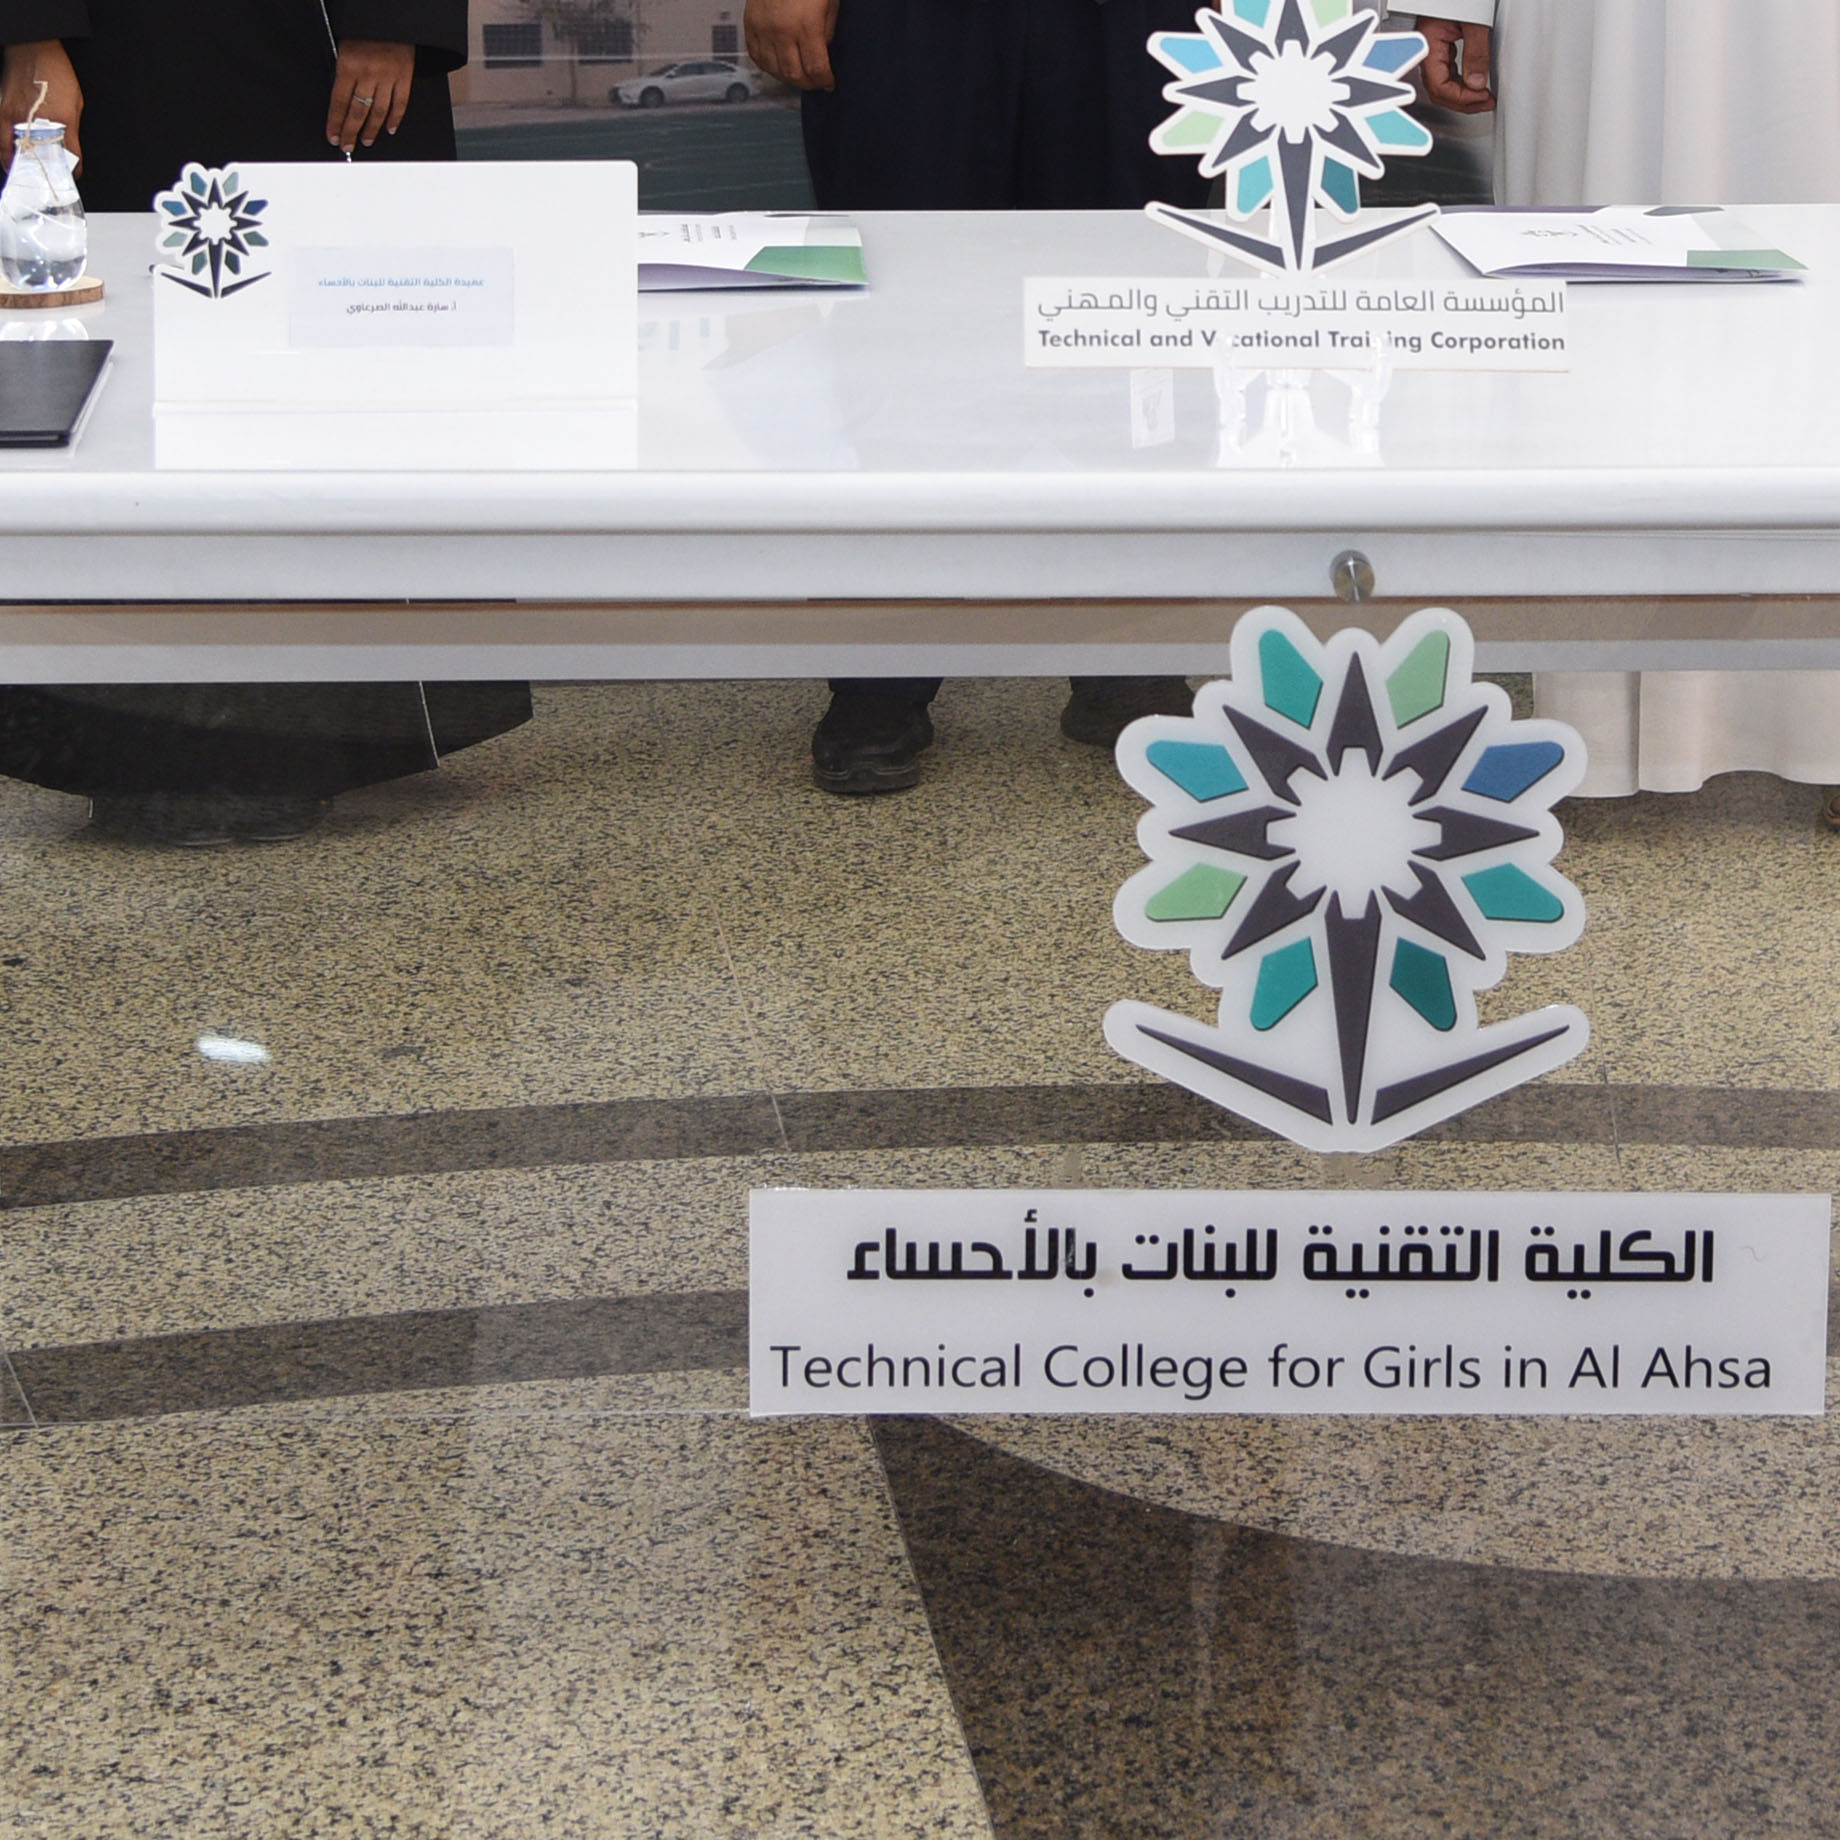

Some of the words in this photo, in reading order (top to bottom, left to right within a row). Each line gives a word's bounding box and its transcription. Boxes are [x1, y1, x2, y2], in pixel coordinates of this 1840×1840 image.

[1038, 288, 1158, 322] والمهني
[1166, 289, 1249, 322] التقني
[1258, 290, 1347, 318] للتدريب
[1356, 289, 1435, 312] العامة
[1443, 288, 1564, 320] المؤسسة
[1038, 328, 1141, 348] Technical
[1150, 328, 1194, 348] and
[1431, 331, 1566, 354] Corporation
[846, 1208, 1098, 1299] بالأحساء
[1121, 1226, 1279, 1299] للبنات
[1303, 1224, 1499, 1300] التقنية
[1525, 1224, 1715, 1300] الكلية
[770, 1344, 1022, 1388] Technical
[1044, 1344, 1248, 1401] College
[1268, 1344, 1342, 1388] for
[1362, 1344, 1482, 1389] Girls
[1504, 1345, 1548, 1388] in
[1568, 1344, 1620, 1388] Al
[1641, 1344, 1773, 1389] Ahsa
